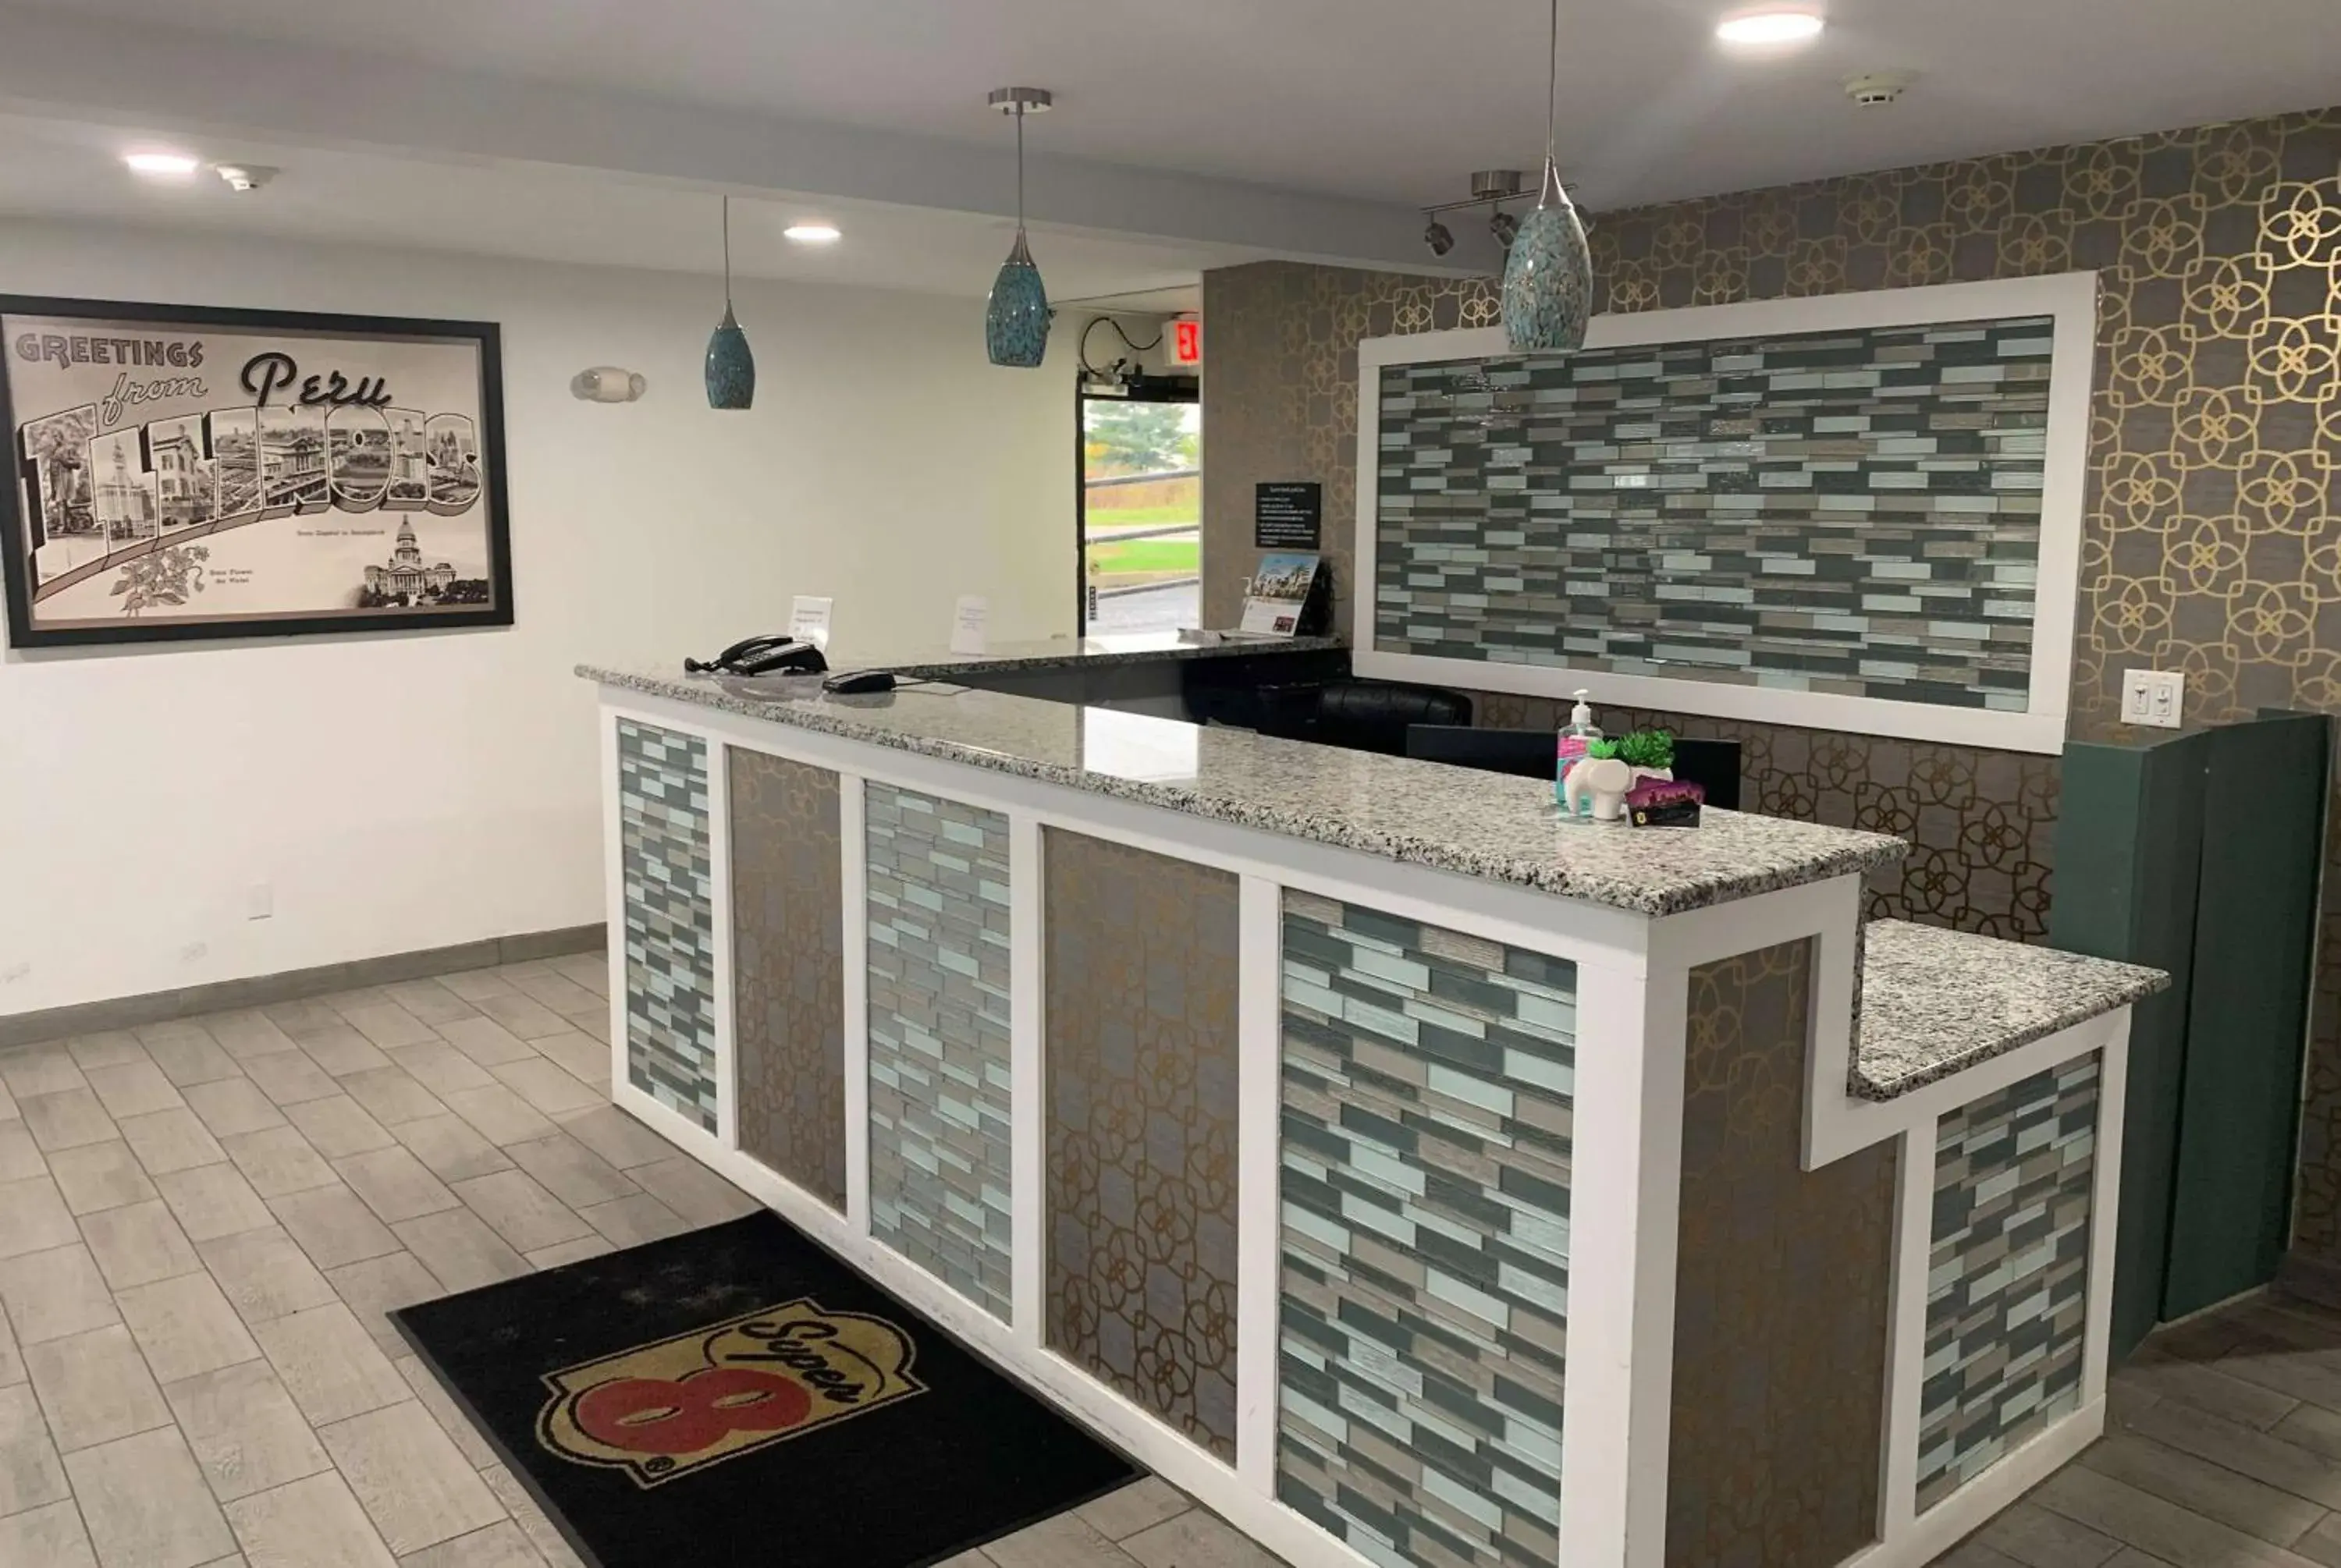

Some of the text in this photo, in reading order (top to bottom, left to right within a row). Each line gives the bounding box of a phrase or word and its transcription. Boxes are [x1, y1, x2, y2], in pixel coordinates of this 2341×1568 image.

[16, 332, 204, 370] GREETINGS
[240, 352, 393, 406] Peru
[101, 372, 208, 426] from
[18, 403, 483, 603] ILLINOIS
[726, 1320, 864, 1403] Super
[577, 1368, 812, 1455] 8
